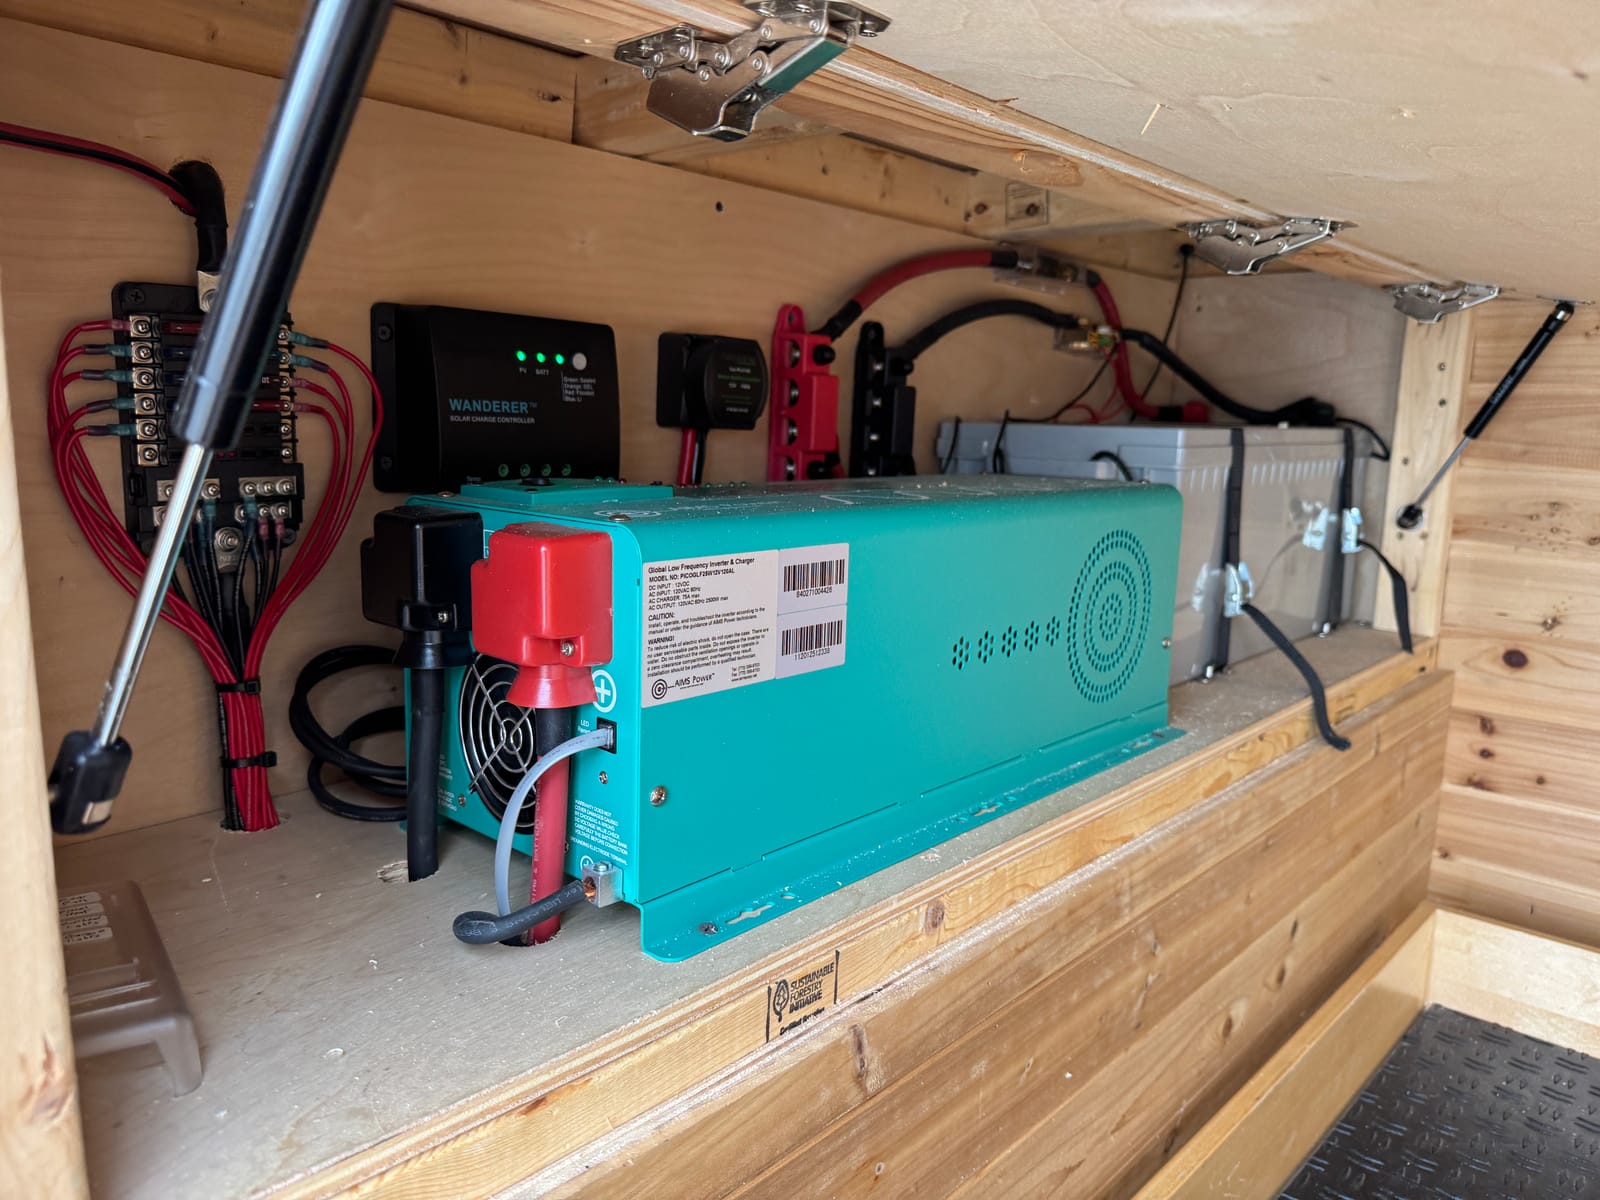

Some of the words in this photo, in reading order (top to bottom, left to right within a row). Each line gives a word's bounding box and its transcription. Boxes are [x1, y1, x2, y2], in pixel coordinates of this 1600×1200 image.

[497, 416, 535, 424] CONTROLLER
[648, 566, 666, 574] Global
[668, 564, 679, 572] Low
[681, 561, 708, 572] Frequency
[710, 559, 729, 567] Inverter
[735, 556, 755, 566] Charger
[649, 575, 668, 583] MODEL
[648, 612, 675, 621] CAUTION:
[648, 635, 674, 645] WARNING!
[675, 677, 691, 687] AIMS
[580, 719, 590, 727] LED
[791, 962, 834, 992] SUSTAINABLE
[790, 979, 824, 1002] FORESTRY
[790, 989, 822, 1014] INITIATIVE
